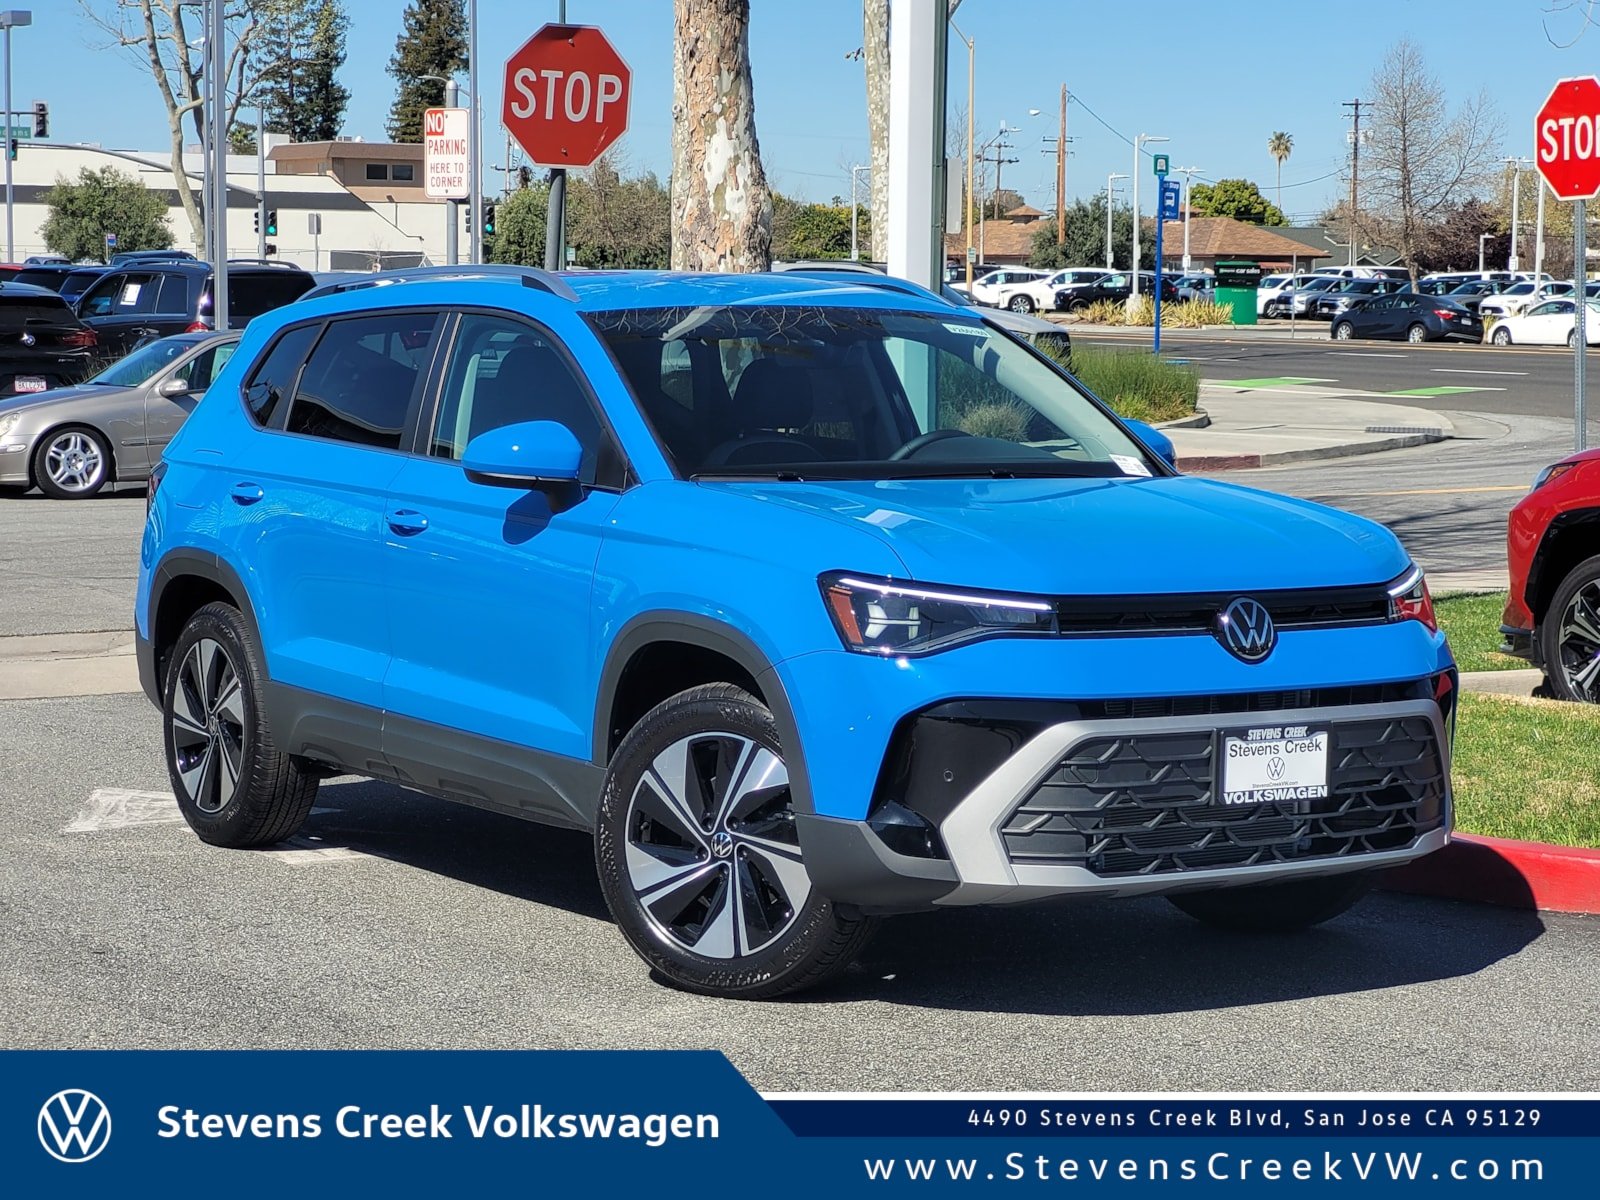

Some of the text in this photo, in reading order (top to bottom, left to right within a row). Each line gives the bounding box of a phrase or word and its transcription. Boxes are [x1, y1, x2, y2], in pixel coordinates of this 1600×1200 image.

[511, 67, 623, 123] STOP
[427, 113, 443, 132] NO
[428, 139, 465, 155] PARKING
[430, 162, 464, 173] HERE TO
[430, 176, 463, 187] CORNER
[1247, 726, 1308, 740] STEVENS CREEK
[1229, 739, 1322, 758] Stevens Creek
[1223, 785, 1328, 805] VOLKSWAGEN
